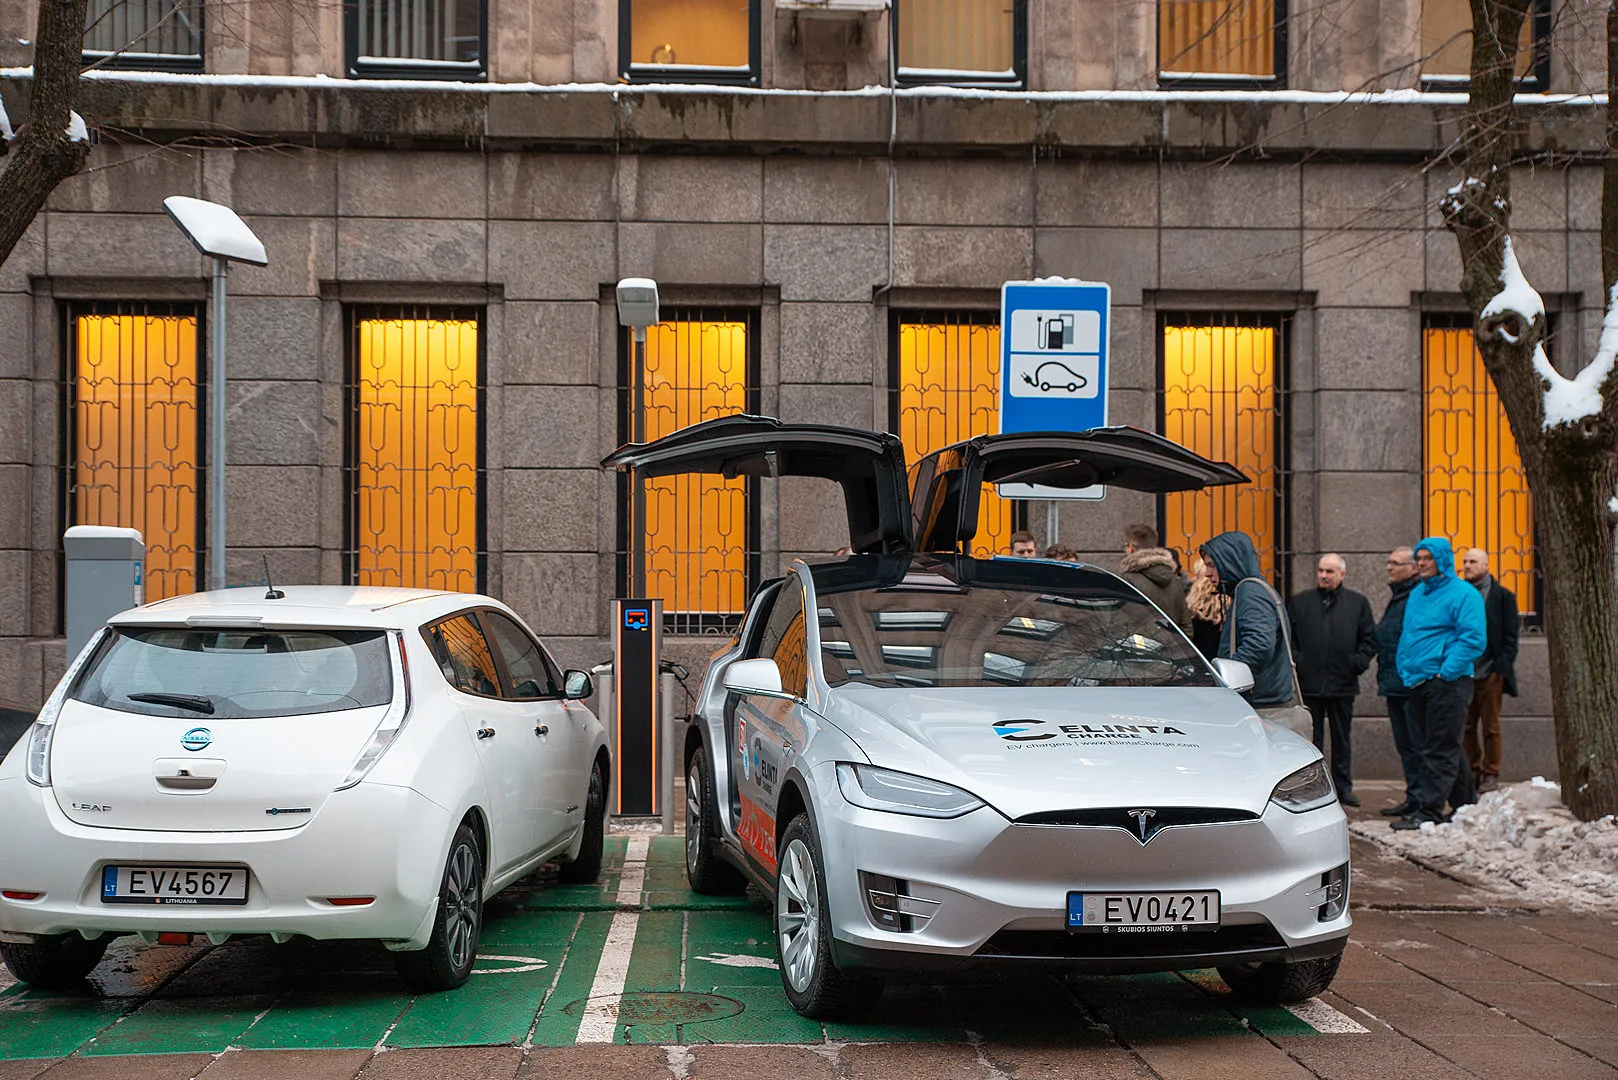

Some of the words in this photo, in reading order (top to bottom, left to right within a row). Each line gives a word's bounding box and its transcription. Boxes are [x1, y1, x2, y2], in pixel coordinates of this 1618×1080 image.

[1058, 724, 1188, 736] ELINTA
[1026, 740, 1073, 749] chargers
[1080, 739, 1200, 749] www.ElintaCharge.com
[104, 884, 116, 892] LT
[129, 870, 233, 896] EV4567
[1070, 913, 1082, 921] LT
[1104, 895, 1209, 923] EV0421
[1146, 925, 1174, 933] SIUNTOS
